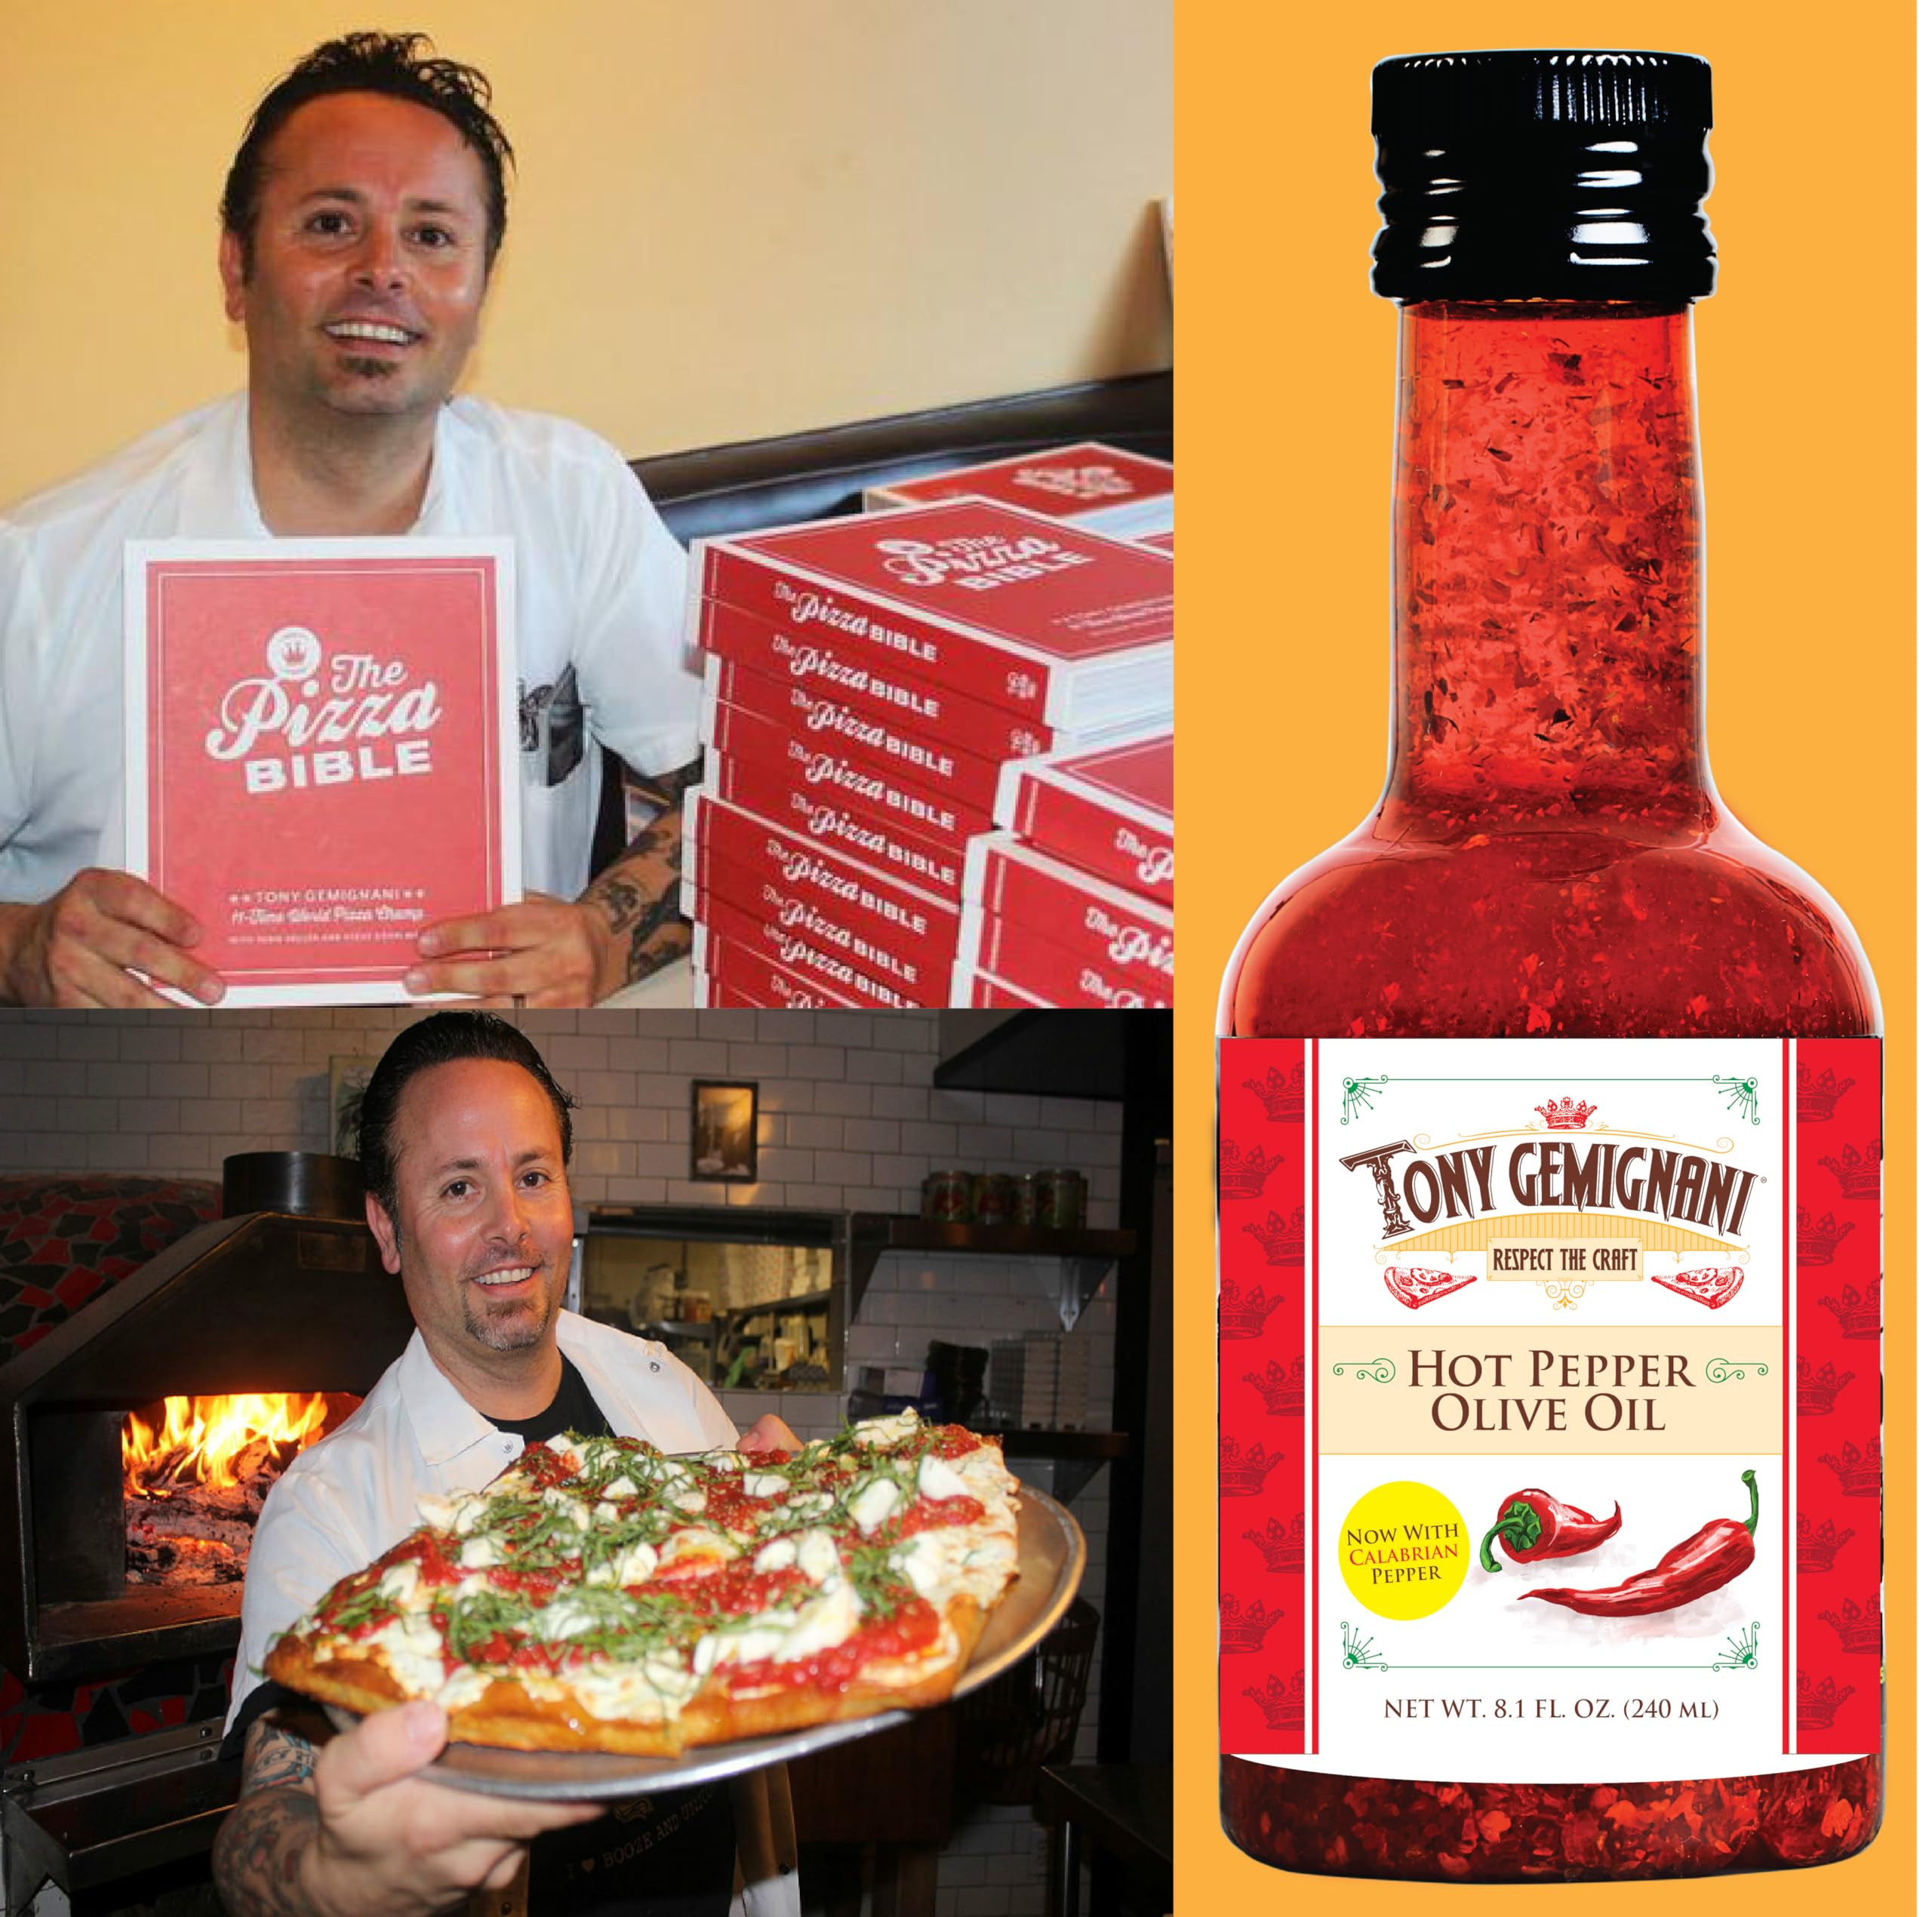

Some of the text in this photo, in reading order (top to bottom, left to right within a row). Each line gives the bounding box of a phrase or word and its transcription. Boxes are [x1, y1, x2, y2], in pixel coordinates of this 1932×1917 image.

[791, 592, 869, 635] Pizza
[869, 624, 937, 662] BIBLE
[330, 654, 409, 692] The
[790, 647, 869, 690] Pizza
[869, 679, 939, 716] BIBLE
[204, 678, 443, 761] Pizza
[808, 701, 884, 746] Pizza
[886, 735, 954, 776] BIBLE
[244, 740, 433, 795] BIBLE
[805, 753, 884, 800] Pizza
[886, 789, 955, 830] BIBLE
[808, 805, 886, 853] Pizza
[887, 842, 955, 885] BIBLE
[783, 853, 858, 900] Pizza
[860, 889, 927, 934] BIBLE
[780, 899, 851, 947] Pizza
[853, 938, 917, 983] BIBLE
[1509, 1142, 1758, 1236] GEMIGNANI
[1493, 1248, 1638, 1271] RESPECT THE CRAFT
[1384, 1700, 1434, 1719] NET
[1441, 1700, 1486, 1719] WT.
[1494, 1699, 1524, 1719] 8.1
[1535, 1700, 1565, 1719] FL.
[1574, 1699, 1614, 1719] OZ.
[1623, 1698, 1672, 1721] (240
[603, 1832, 654, 1870] BOOZE
